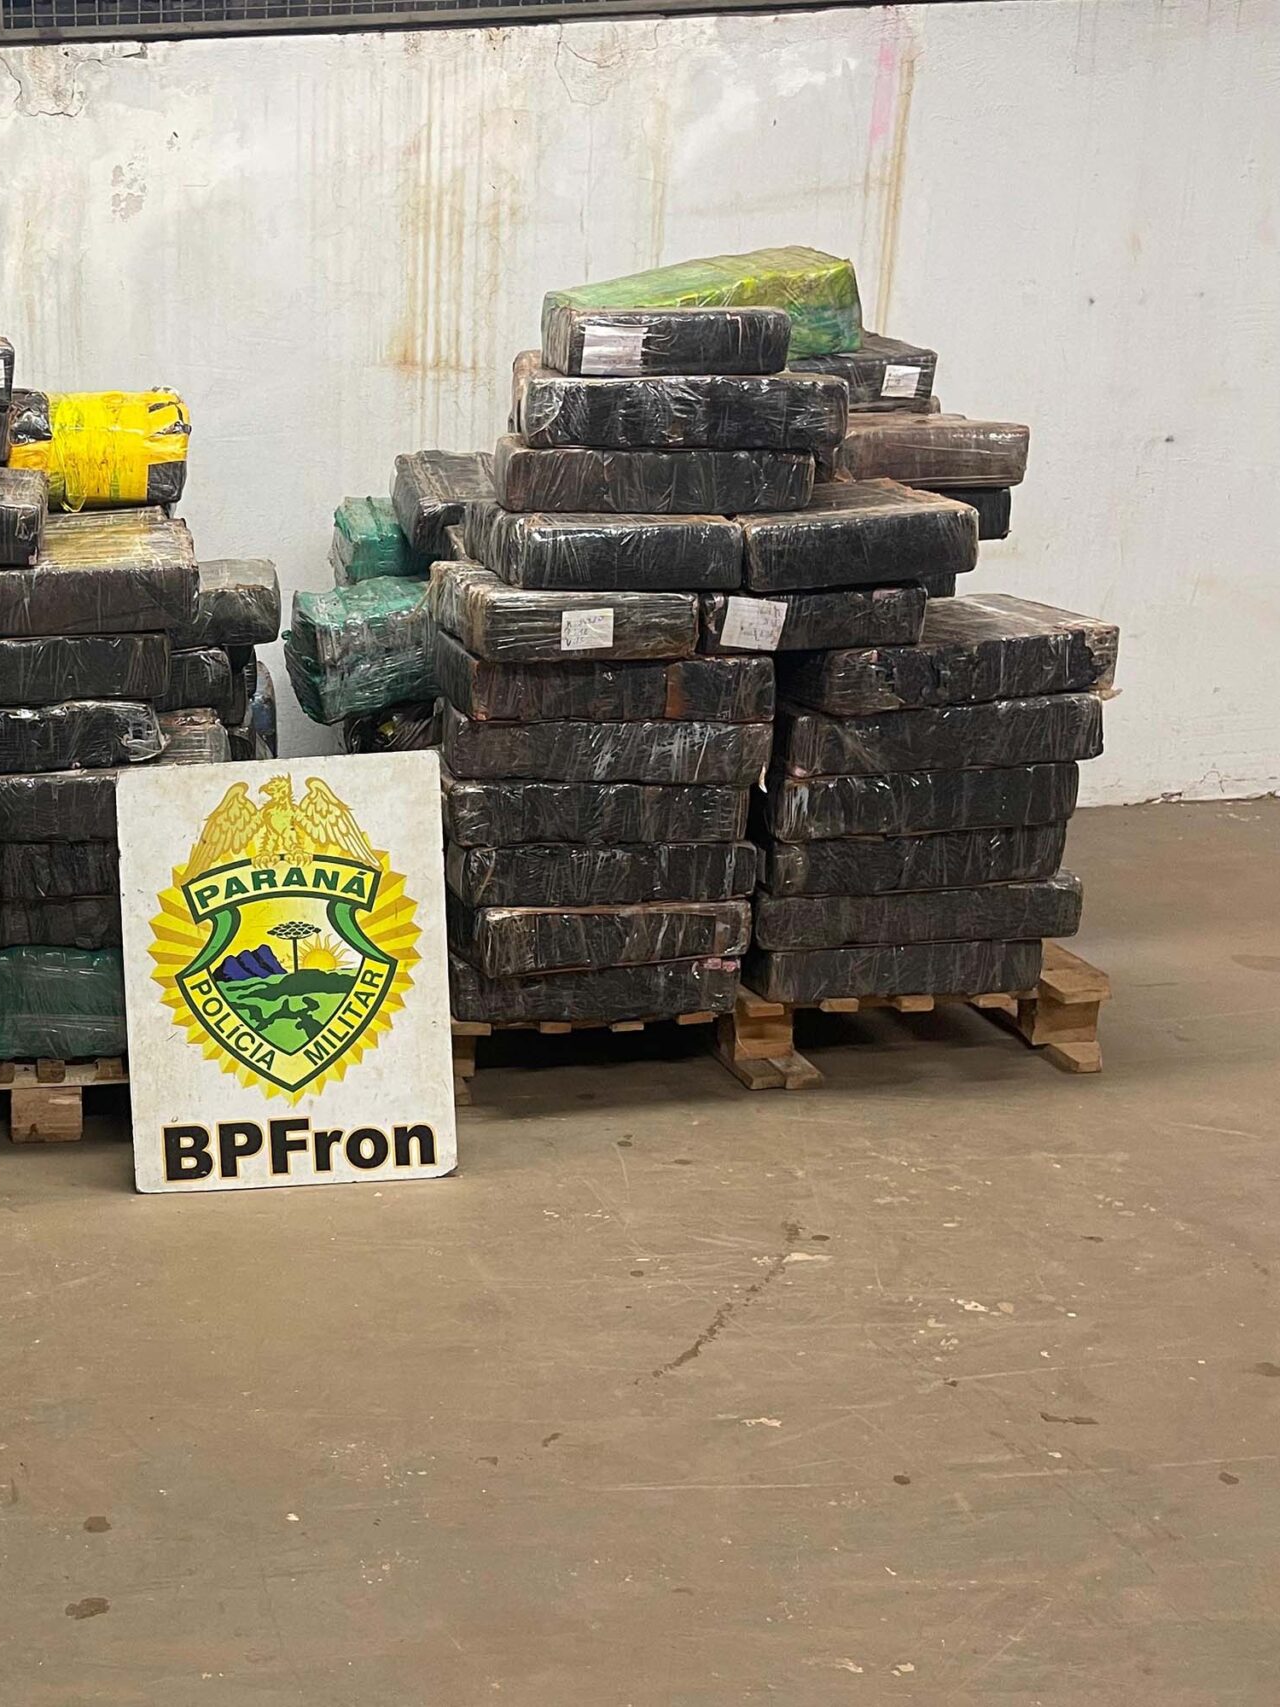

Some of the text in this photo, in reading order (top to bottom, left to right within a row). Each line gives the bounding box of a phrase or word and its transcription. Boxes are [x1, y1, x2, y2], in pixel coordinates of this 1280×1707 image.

[194, 866, 367, 909] PARANÁ
[189, 978, 276, 1071] POLÍCIA
[303, 968, 384, 1067] MILITAR
[162, 1117, 437, 1182] BPFron
